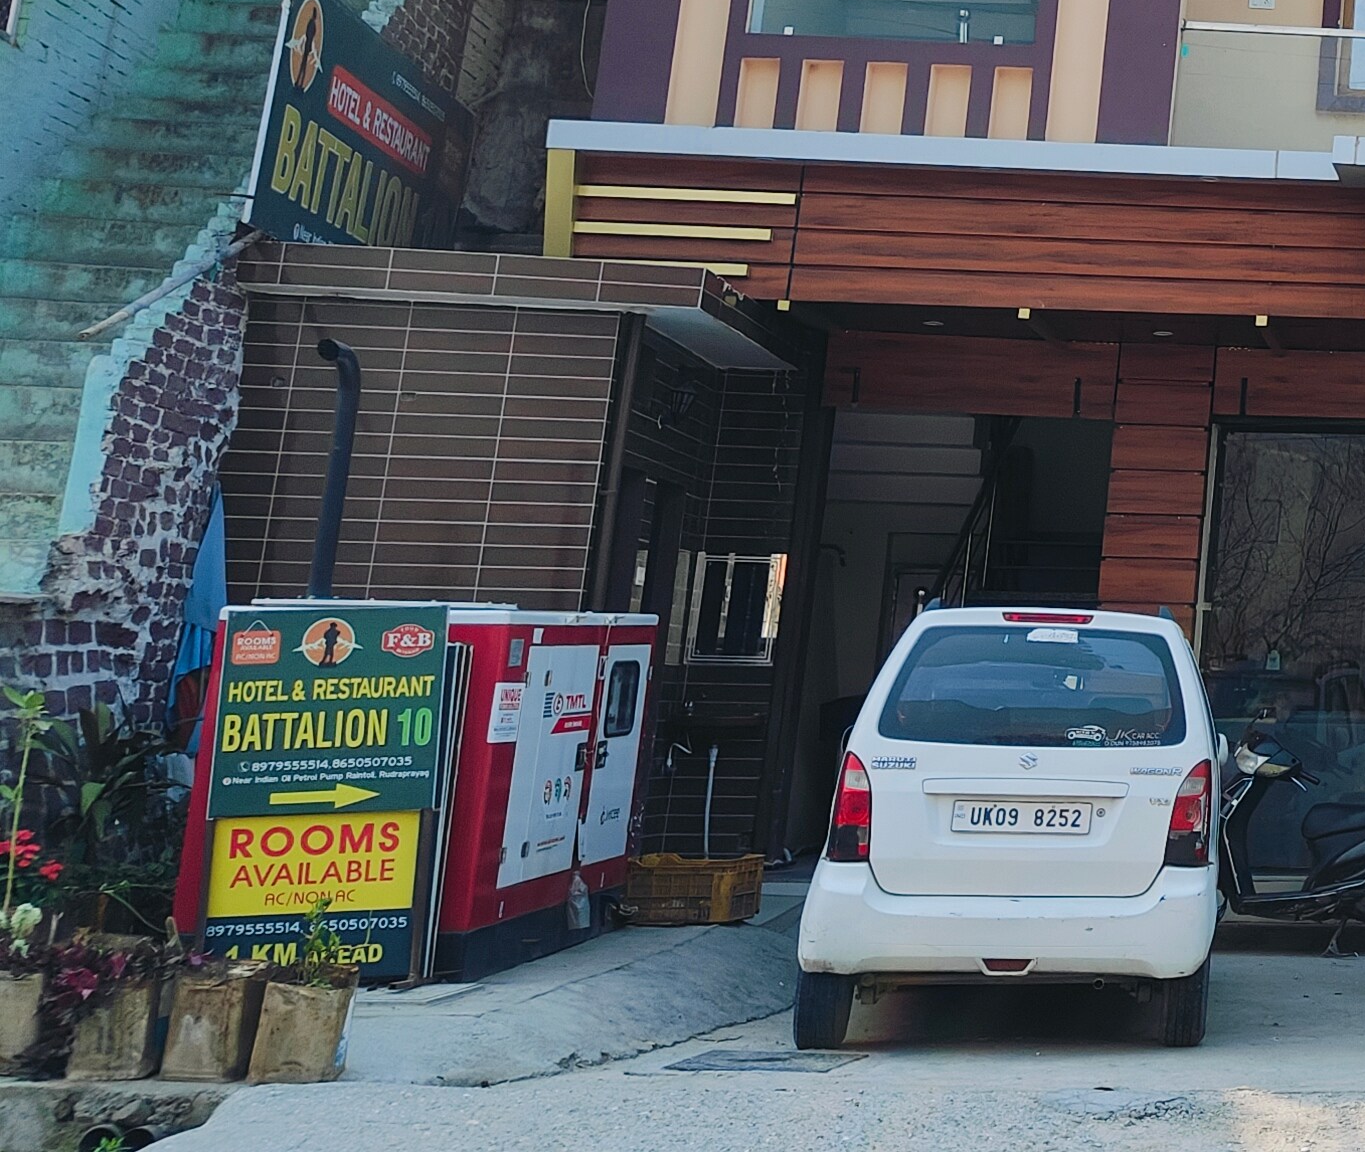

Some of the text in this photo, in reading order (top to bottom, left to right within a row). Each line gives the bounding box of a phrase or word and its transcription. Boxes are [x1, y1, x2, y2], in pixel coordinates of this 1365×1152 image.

[329, 76, 360, 125] HOTEL
[362, 100, 372, 131] &
[372, 107, 431, 172] RESTAURANT
[271, 103, 421, 247] BATTALION
[237, 637, 276, 646] ROOMS
[386, 633, 432, 647] F&B
[228, 676, 435, 703] HOTEL & RESTAURANT
[566, 694, 586, 710] TMTL
[221, 707, 433, 753] BATTALION 10
[251, 756, 413, 772] 8979555514,8650507035
[232, 776, 251, 785] Near
[254, 775, 278, 784] Indian
[281, 774, 291, 782] Oil
[293, 772, 318, 782] Petrol
[319, 772, 344, 782] Pump
[379, 770, 430, 780] Rudraprayag
[970, 807, 1082, 828] UK09 8252
[229, 822, 400, 859] ROOMS
[229, 858, 395, 889] AVAILABLE
[264, 889, 356, 907] AC/NON AC
[251, 943, 297, 967] KM
[307, 944, 383, 964] AEAD
